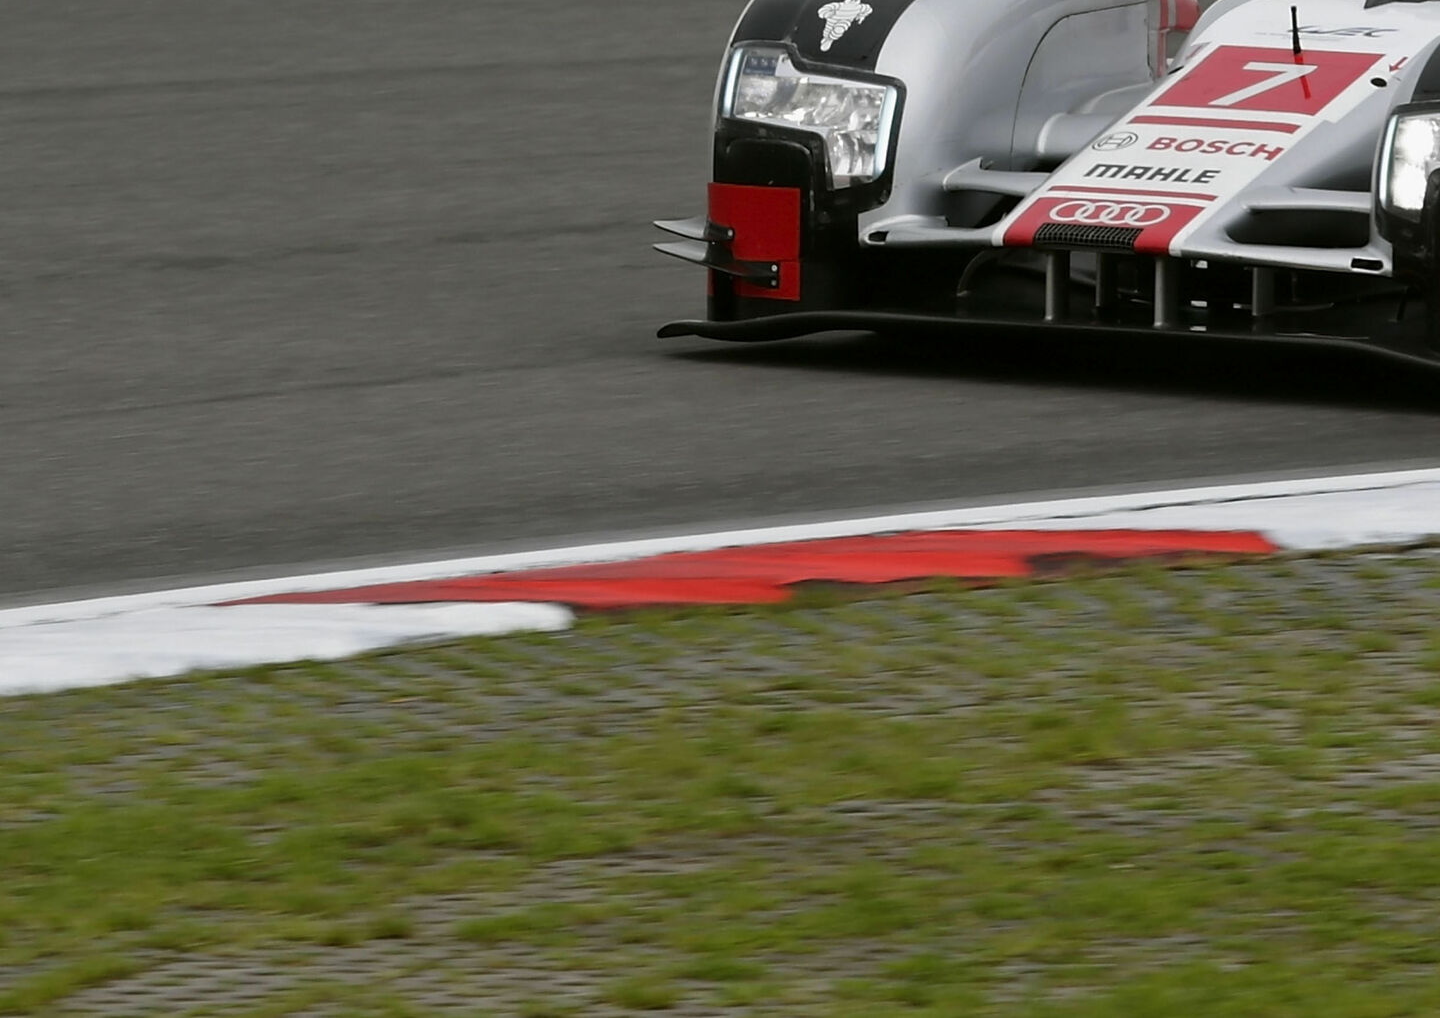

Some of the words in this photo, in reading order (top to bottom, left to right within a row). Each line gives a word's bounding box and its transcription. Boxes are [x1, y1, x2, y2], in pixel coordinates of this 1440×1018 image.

[1208, 61, 1318, 107] 7
[1145, 137, 1285, 162] BOSCH
[1083, 163, 1222, 184] MAHLE
